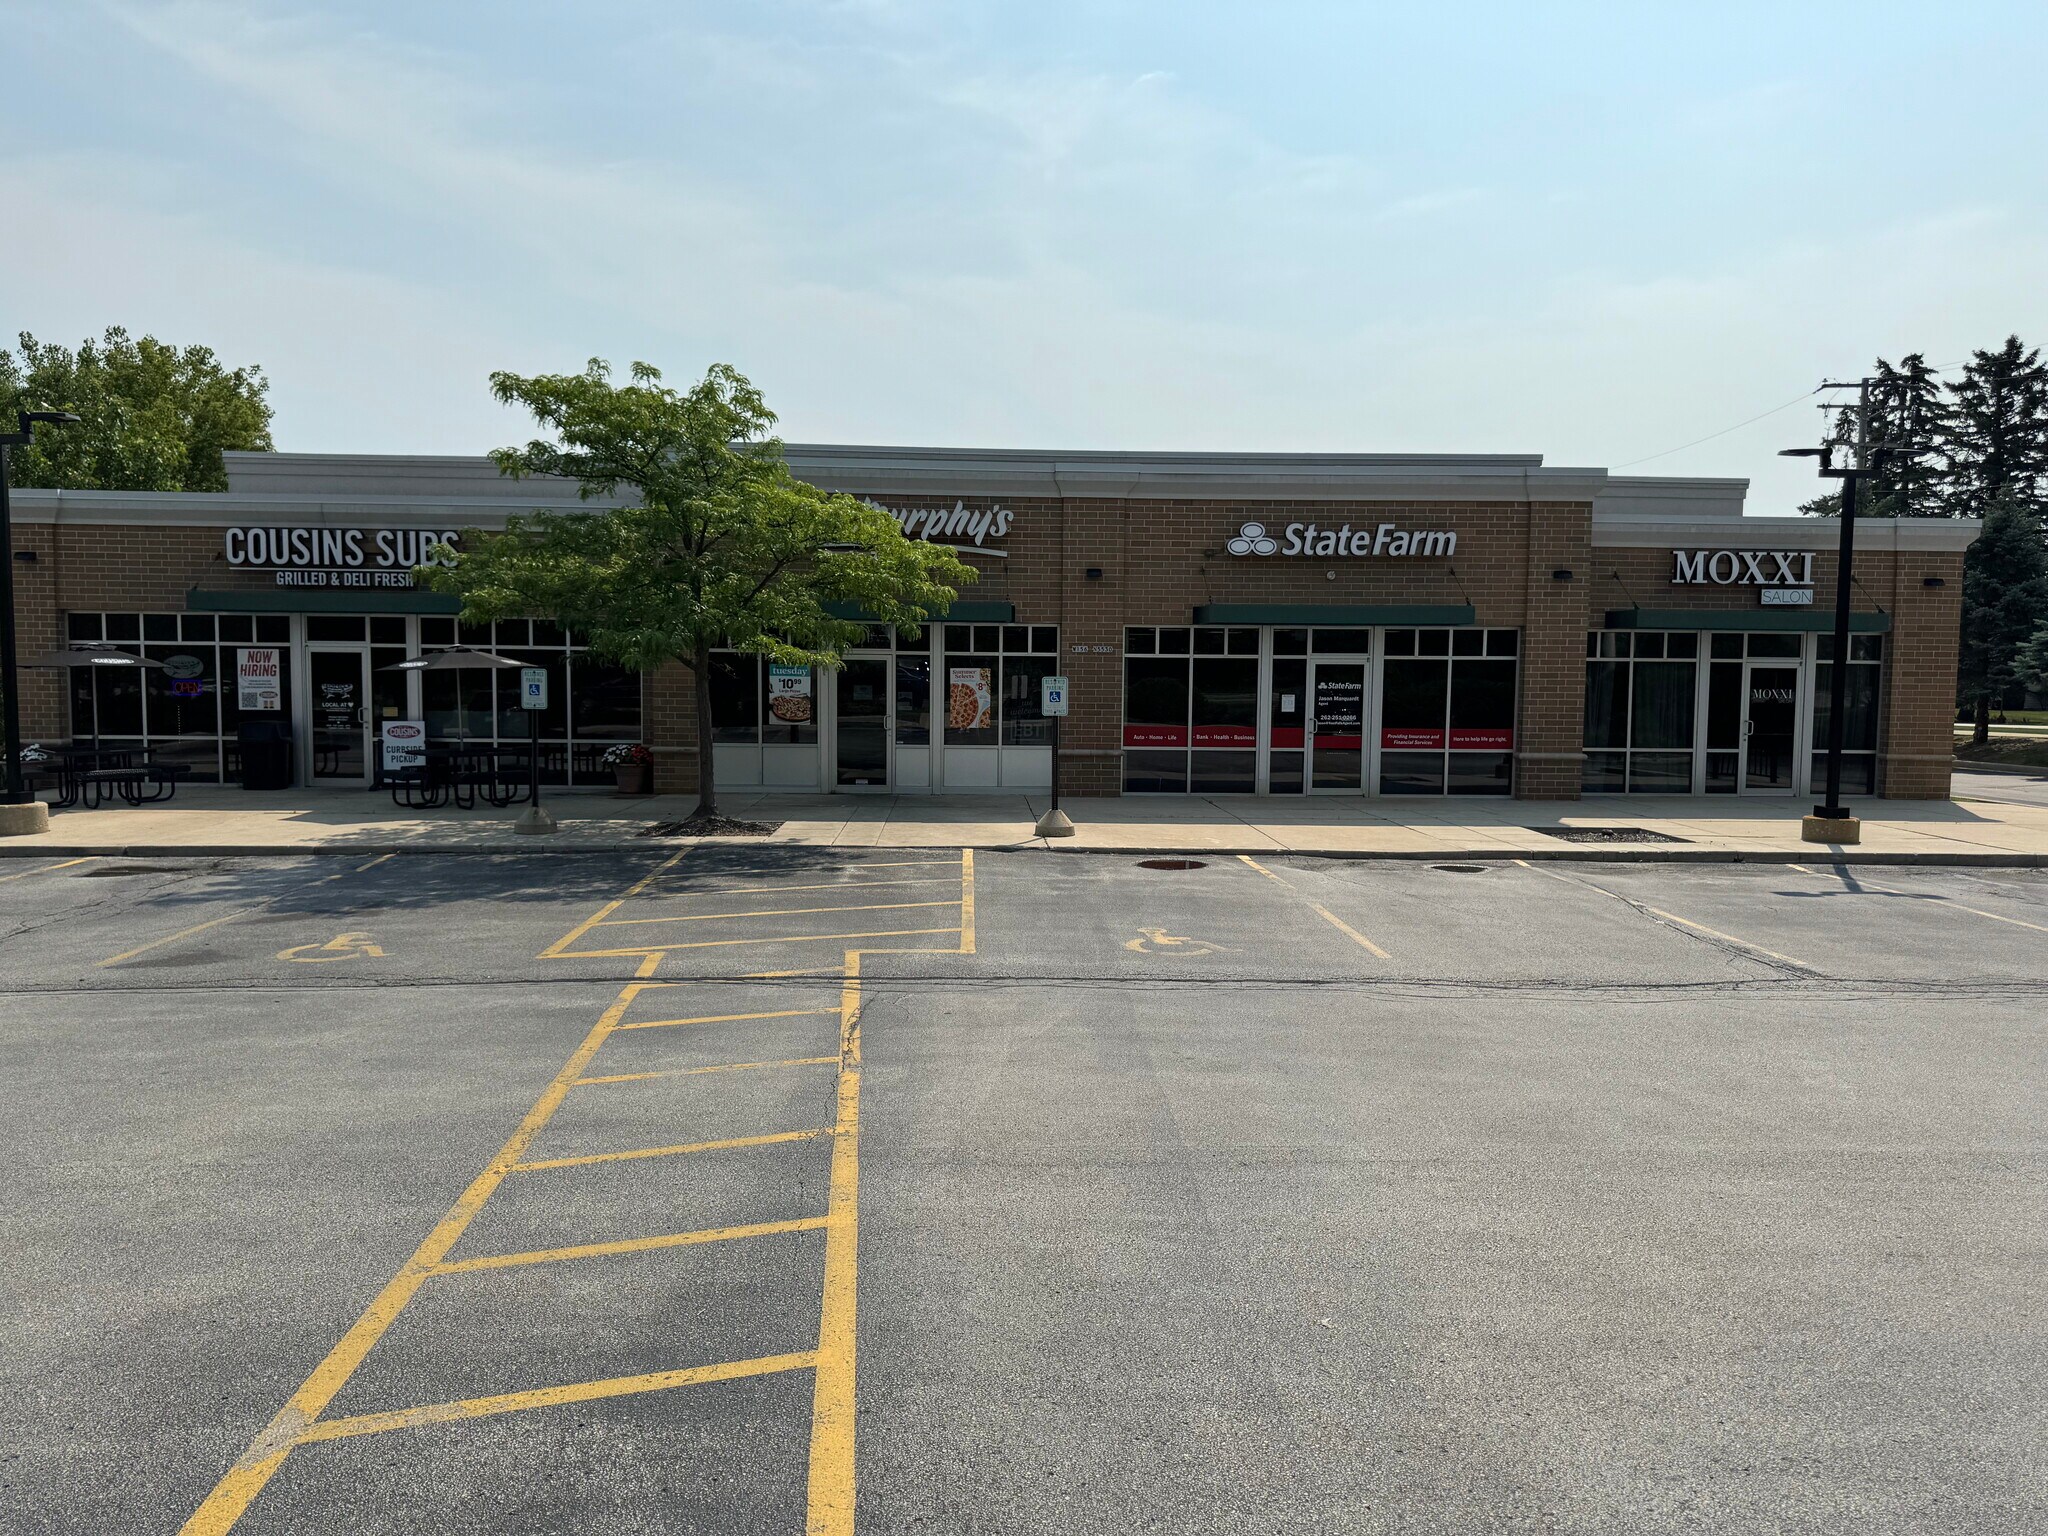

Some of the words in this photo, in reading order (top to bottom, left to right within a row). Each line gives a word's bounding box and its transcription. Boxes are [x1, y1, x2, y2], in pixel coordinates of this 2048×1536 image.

[863, 495, 1014, 546] urphy's
[225, 527, 364, 566] COUSINS
[376, 529, 460, 568] SUBS
[1672, 550, 1816, 585] MOXXI
[276, 571, 327, 586] GRILLED
[331, 573, 340, 586] &
[344, 573, 371, 587] DELI
[375, 573, 414, 588] FRESH
[1762, 590, 1812, 603] SALON
[247, 650, 274, 664] NOW
[240, 663, 278, 677] HIRING
[772, 666, 808, 676] tuesday
[1753, 689, 1792, 699] MOXXI
[389, 727, 419, 736] COUSINS
[386, 745, 423, 754] CURBSIDE
[391, 755, 418, 763] PICKUP
